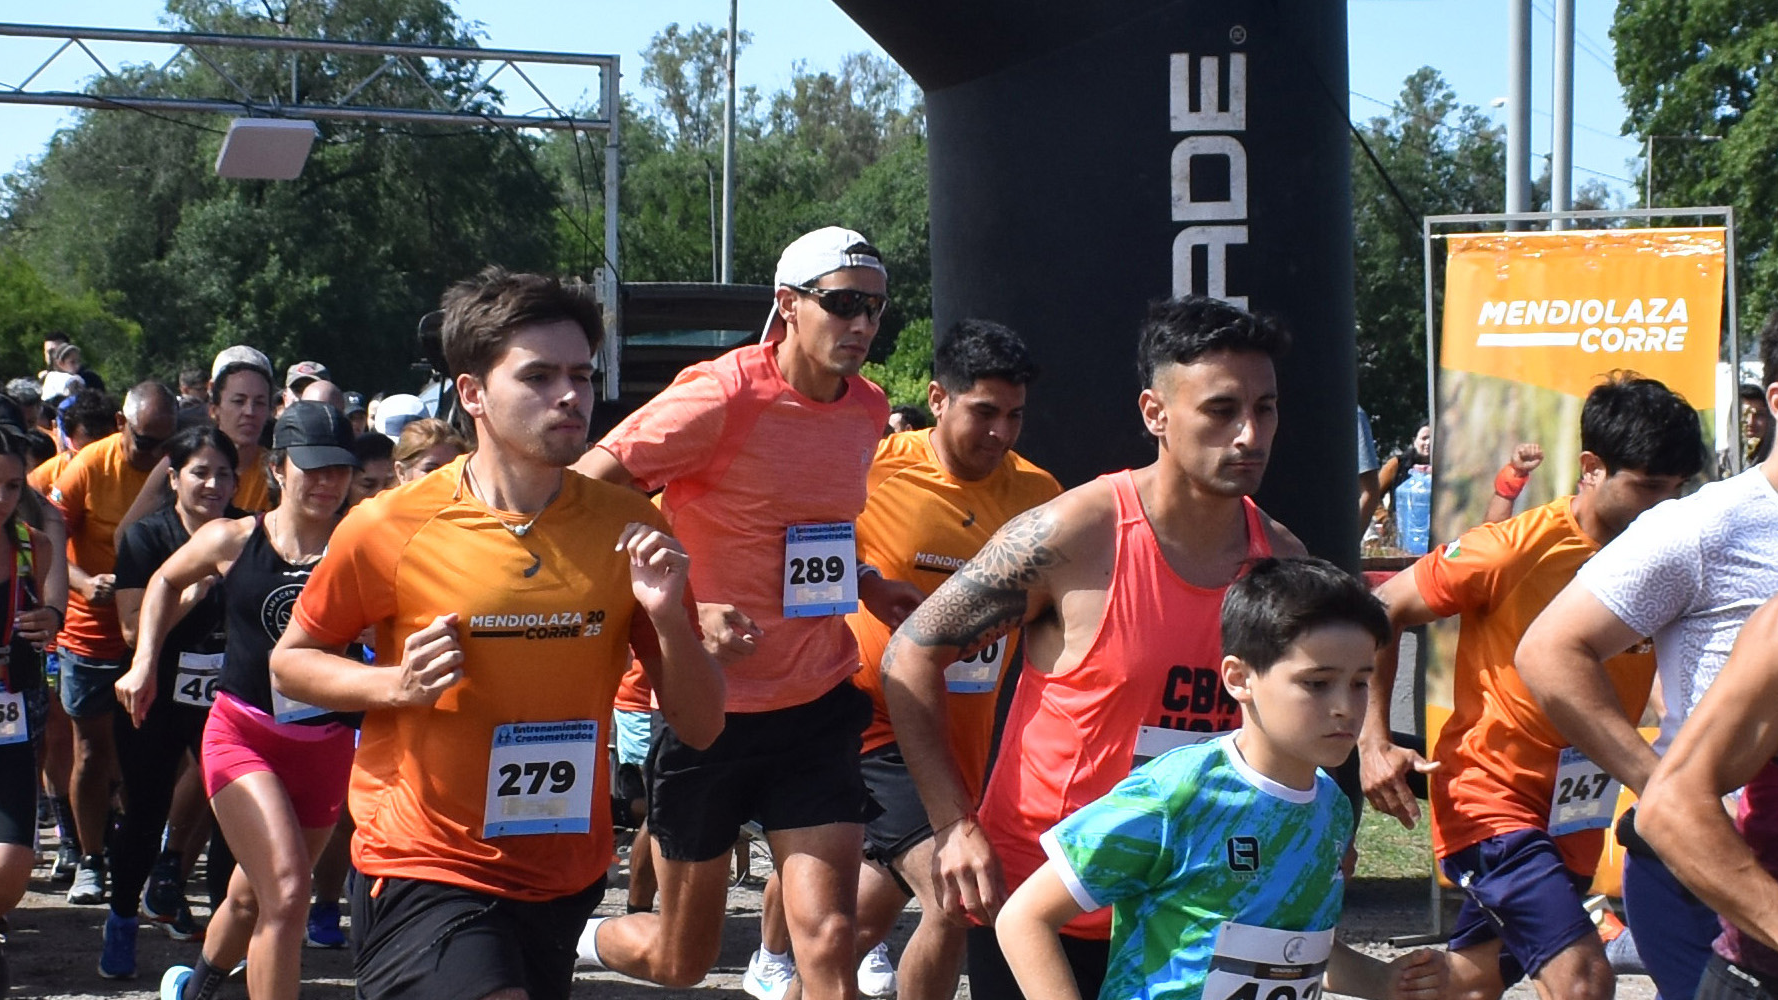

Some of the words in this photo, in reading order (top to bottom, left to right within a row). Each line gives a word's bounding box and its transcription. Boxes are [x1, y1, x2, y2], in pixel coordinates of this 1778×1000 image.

[1477, 297, 1689, 326] MENDIOLAZA
[1580, 325, 1689, 353] CORRE
[789, 555, 845, 585] 289
[915, 551, 966, 569] MENDIO
[470, 612, 582, 628] MENDIOLAZA
[586, 610, 606, 624] 20
[525, 625, 582, 640] CORRE
[583, 623, 602, 637] 25
[512, 722, 594, 734] Entrenamientos
[515, 731, 593, 743] Cronometrados
[497, 760, 576, 797] 279
[1557, 772, 1612, 806] 247
